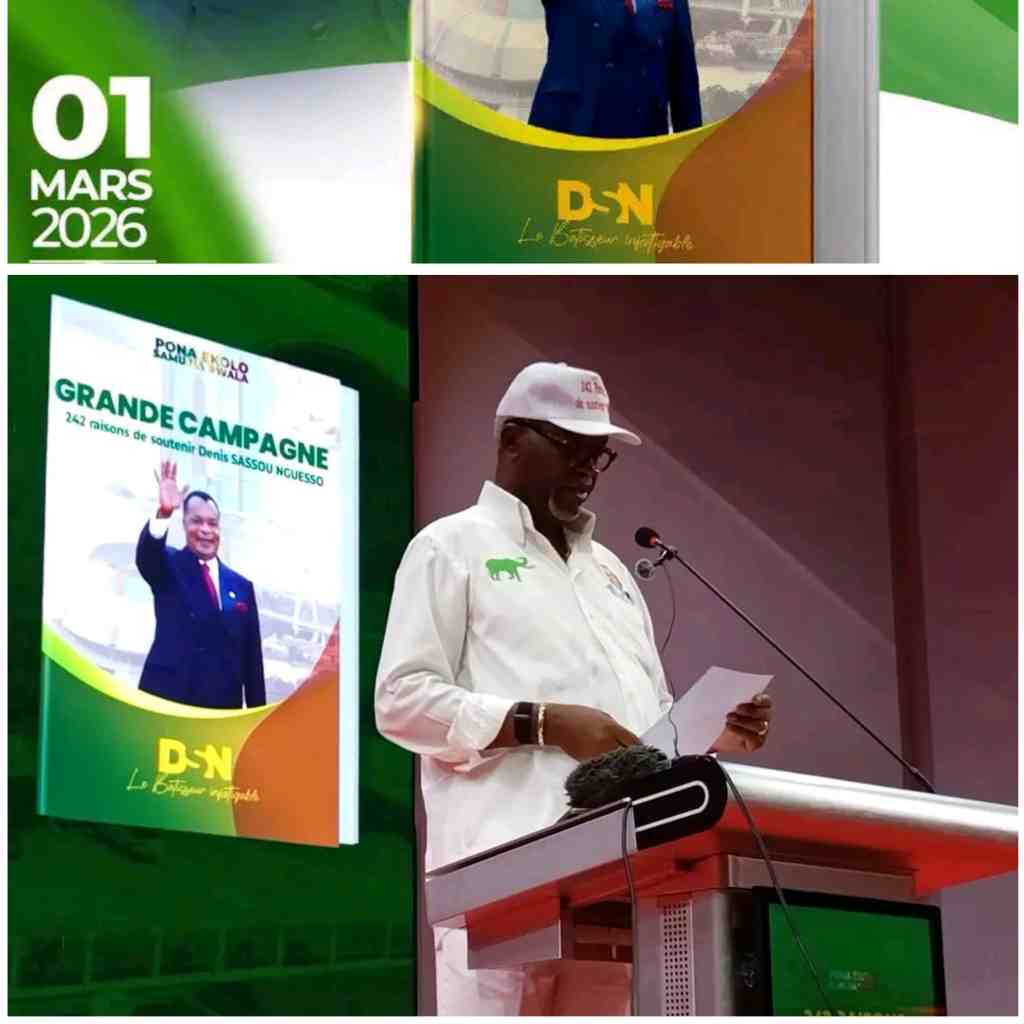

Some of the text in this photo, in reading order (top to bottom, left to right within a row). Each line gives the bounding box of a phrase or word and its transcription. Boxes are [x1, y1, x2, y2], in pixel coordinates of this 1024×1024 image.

[32, 74, 151, 160] 01
[31, 169, 153, 201] MARS
[557, 179, 654, 226] DSN
[32, 206, 148, 248] 2026
[153, 348, 187, 366] SAMU
[154, 337, 198, 360] PONA
[54, 378, 329, 470] GRANDE CAMPAGNE
[65, 411, 325, 487] 242 raisons de soutenir Denis SASSOU NGUESSO
[158, 737, 233, 781] DSN
